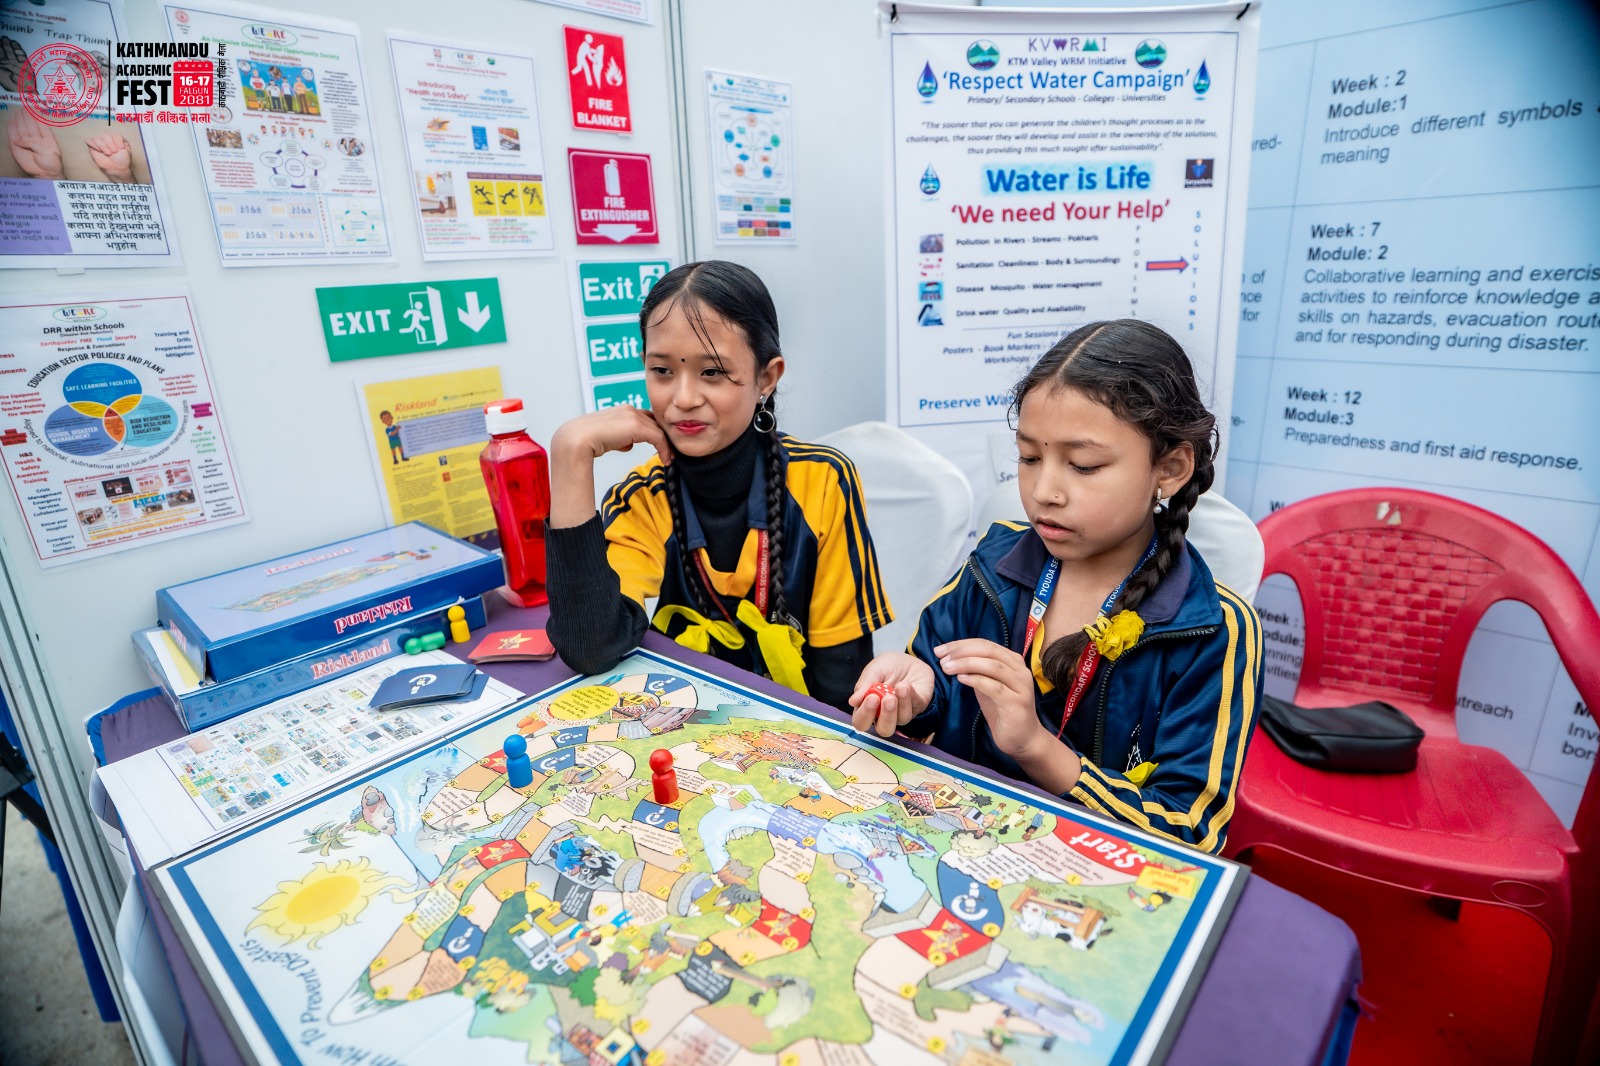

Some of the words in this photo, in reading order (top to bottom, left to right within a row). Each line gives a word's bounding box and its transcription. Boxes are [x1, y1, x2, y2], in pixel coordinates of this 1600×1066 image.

[44, 29, 72, 41] Trap
[1033, 58, 1057, 67] Valley
[1061, 57, 1085, 65] WRM
[1088, 57, 1126, 65] Initiative
[1030, 72, 1087, 88] Water
[1332, 72, 1378, 94] Week
[1395, 70, 1406, 86] 2
[588, 98, 613, 111] FIRE
[1005, 96, 1045, 104] Secondary
[1048, 95, 1076, 103] Schools
[1083, 94, 1114, 103] Colleges
[577, 112, 627, 128] BLANKET
[1324, 122, 1400, 143] Introduce
[1411, 111, 1487, 134] different
[1497, 98, 1584, 127] symbols
[1320, 145, 1390, 165] meaning
[986, 169, 1070, 193] Water
[1078, 167, 1097, 191] is
[1106, 165, 1150, 190] Life
[604, 196, 626, 208] FIRE
[580, 209, 650, 221] EXTINGUISHER
[1002, 203, 1055, 222] need
[1063, 203, 1110, 221] Your
[1310, 223, 1354, 239] Week
[1371, 222, 1381, 237] 7
[1046, 259, 1064, 267] Body
[1074, 257, 1120, 265] Surroundings
[1307, 247, 1372, 262] Module:
[1378, 245, 1388, 260] 2
[1304, 268, 1406, 284] Collaborative
[1411, 268, 1481, 287] learning
[1487, 265, 1523, 282] and
[583, 277, 634, 302] Exit
[991, 284, 1025, 292] Mosquito
[1056, 281, 1102, 289] management
[1301, 290, 1366, 304] activities
[1372, 291, 1387, 304] to
[1394, 290, 1468, 304] reinforce
[1476, 288, 1580, 308] knowledge
[1003, 308, 1029, 316] Quality
[1047, 305, 1086, 314] Availability
[1298, 310, 1333, 324] skills
[1341, 312, 1360, 324] on
[1368, 310, 1437, 327] hazards,
[1447, 311, 1548, 328] evacuation
[64, 324, 91, 332] within
[94, 322, 124, 331] Schools
[329, 309, 391, 337] EXIT
[589, 336, 639, 362] Exit
[1296, 329, 1322, 343] and
[1327, 329, 1347, 344] for
[1351, 330, 1441, 350] responding
[1446, 332, 1502, 352] during
[1508, 334, 1589, 352] disaster.
[27, 362, 61, 388] EDUCATION
[60, 352, 89, 366] SECTOR
[91, 352, 125, 360] POLICIES
[127, 355, 142, 364] AND
[143, 360, 165, 374] PLANS
[81, 382, 108, 390] LEARNING
[109, 378, 137, 387] FACILITIES
[394, 398, 437, 412] Riskland
[597, 394, 643, 412] Eit
[919, 397, 981, 410] Preserve
[1287, 386, 1328, 402] Week
[1344, 390, 1362, 405] 12
[1284, 427, 1386, 452] Preparedness
[1390, 438, 1420, 454] and
[1425, 441, 1455, 458] first
[1459, 445, 1485, 461] aid
[1491, 451, 1583, 472] response.
[1039, 569, 1055, 597] TYOUDA
[334, 596, 413, 634] Riskland
[311, 639, 391, 679] Riskland
[1067, 671, 1089, 717] SECONDARY
[1083, 642, 1097, 673] SCHOO
[1069, 832, 1146, 868] Start
[239, 939, 309, 972] Disasters
[298, 968, 322, 1024] Prevent
[300, 1028, 327, 1046] To
